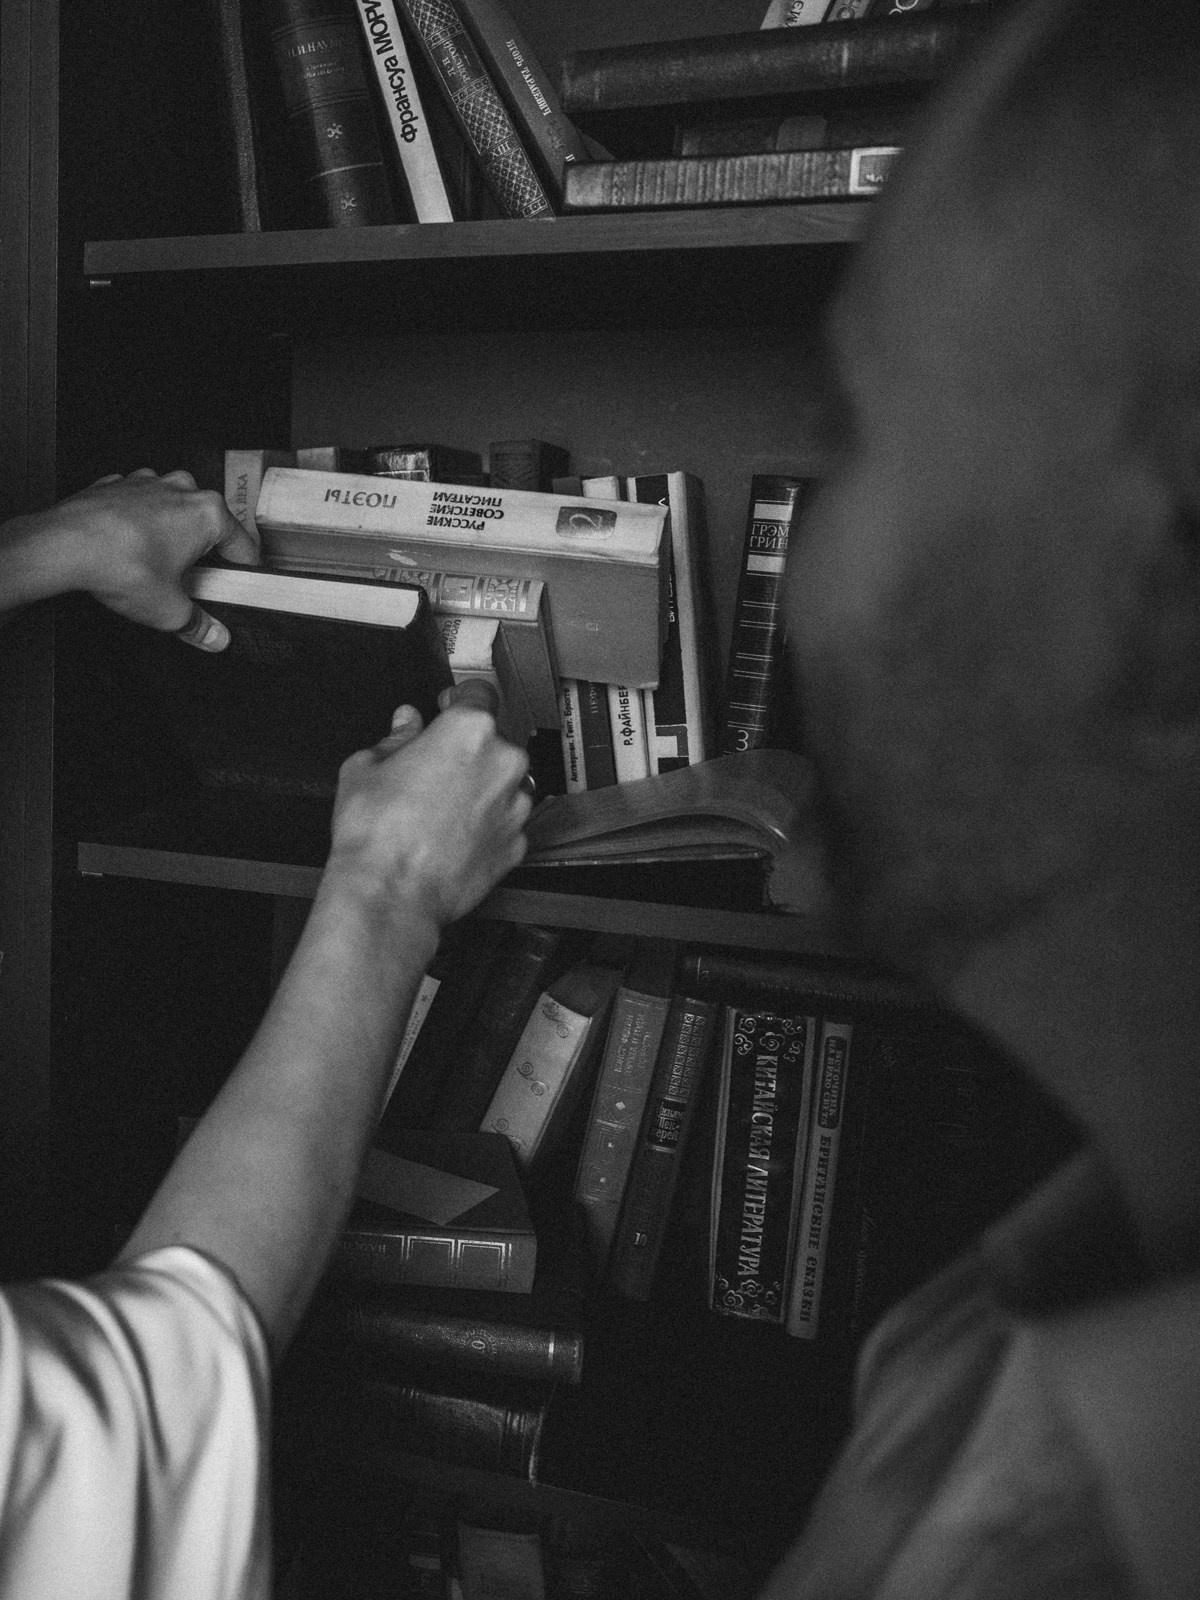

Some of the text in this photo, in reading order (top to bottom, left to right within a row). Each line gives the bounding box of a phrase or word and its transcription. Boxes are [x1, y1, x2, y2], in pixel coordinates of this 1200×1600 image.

[505, 38, 553, 117] ИГОРЬ ТАРАСЕВИЧ
[384, 56, 417, 144] Франсуа
[237, 473, 248, 507] ВЕКА
[324, 488, 398, 510] ПОЭТЫ
[432, 490, 504, 508] ПИСАТЕЛИ
[429, 502, 505, 521] СОВЕТСКИЕ
[569, 513, 603, 531] 2
[426, 514, 486, 532] РУССКИЕ
[751, 523, 789, 538] ГРЭМ
[749, 535, 788, 550] ГРИН
[565, 712, 576, 738] Гент.
[736, 730, 749, 751] 3
[737, 1055, 778, 1277] КИТАЙСКАЯ ЛИТЕРАТУРА
[800, 1135, 832, 1323] БРИТАНСКИЕ СКАЗКИ
